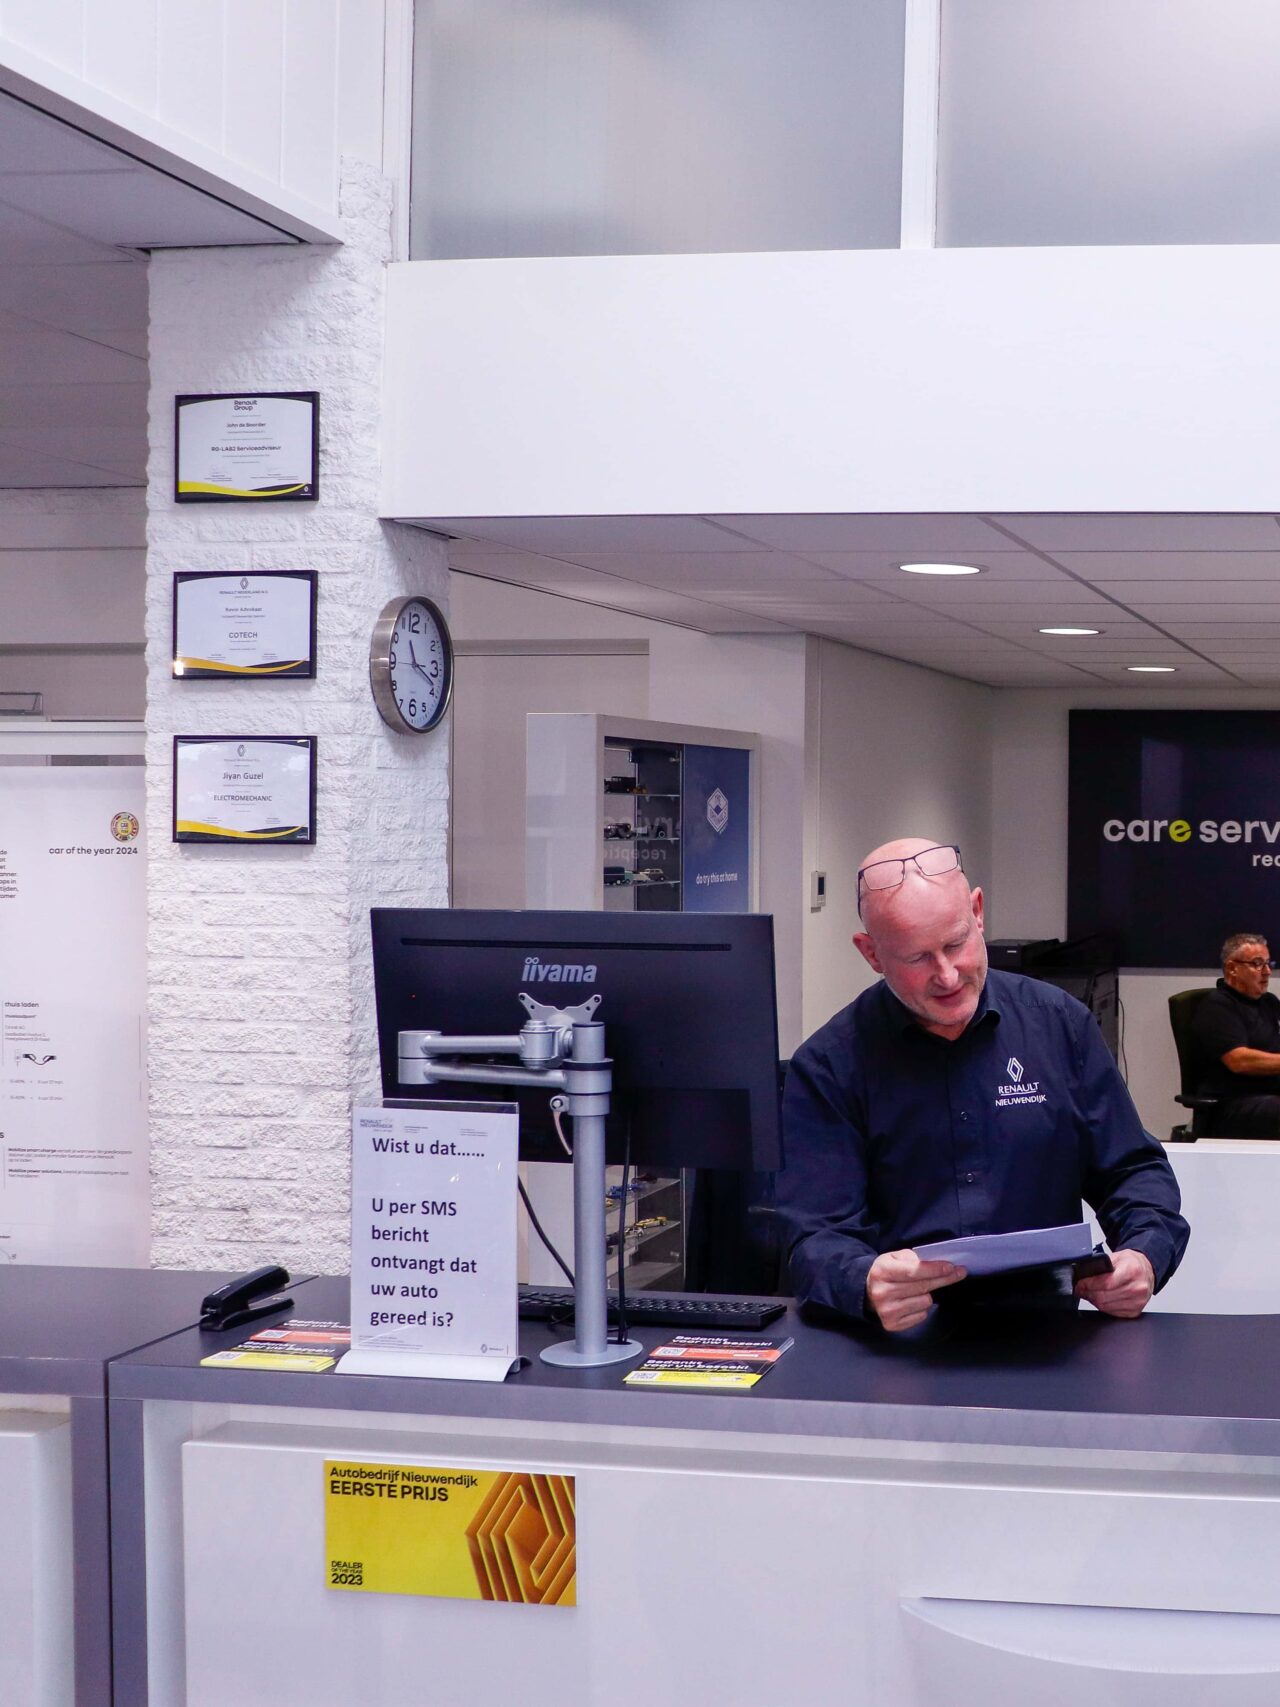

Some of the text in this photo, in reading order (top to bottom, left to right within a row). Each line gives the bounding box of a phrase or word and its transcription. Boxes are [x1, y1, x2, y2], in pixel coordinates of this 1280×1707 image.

[409, 612, 420, 634] 12
[430, 660, 439, 678] 3
[408, 698, 417, 717] 6
[422, 702, 427, 712] 5
[222, 772, 241, 780] Jiyan
[1103, 819, 1192, 843] care
[66, 846, 76, 854] of
[77, 846, 92, 854] the
[94, 848, 114, 856] year
[521, 957, 598, 983] iiyama
[997, 1081, 1040, 1095] RENAULT
[995, 1094, 1047, 1107] NIEUWENDIJK
[372, 1137, 410, 1154] Wist
[415, 1143, 424, 1154] u
[372, 1198, 457, 1216] U per SMS
[371, 1224, 430, 1242] bericht
[371, 1255, 478, 1274] ontvangt dat
[371, 1284, 438, 1298] uw auto
[370, 1311, 454, 1327] gereed is?
[330, 1467, 478, 1488] Autobedrijf Nieuwendijk
[330, 1480, 449, 1502] EERSTE PRIJS
[331, 1560, 363, 1569] DEALER
[331, 1573, 363, 1586] 2023
